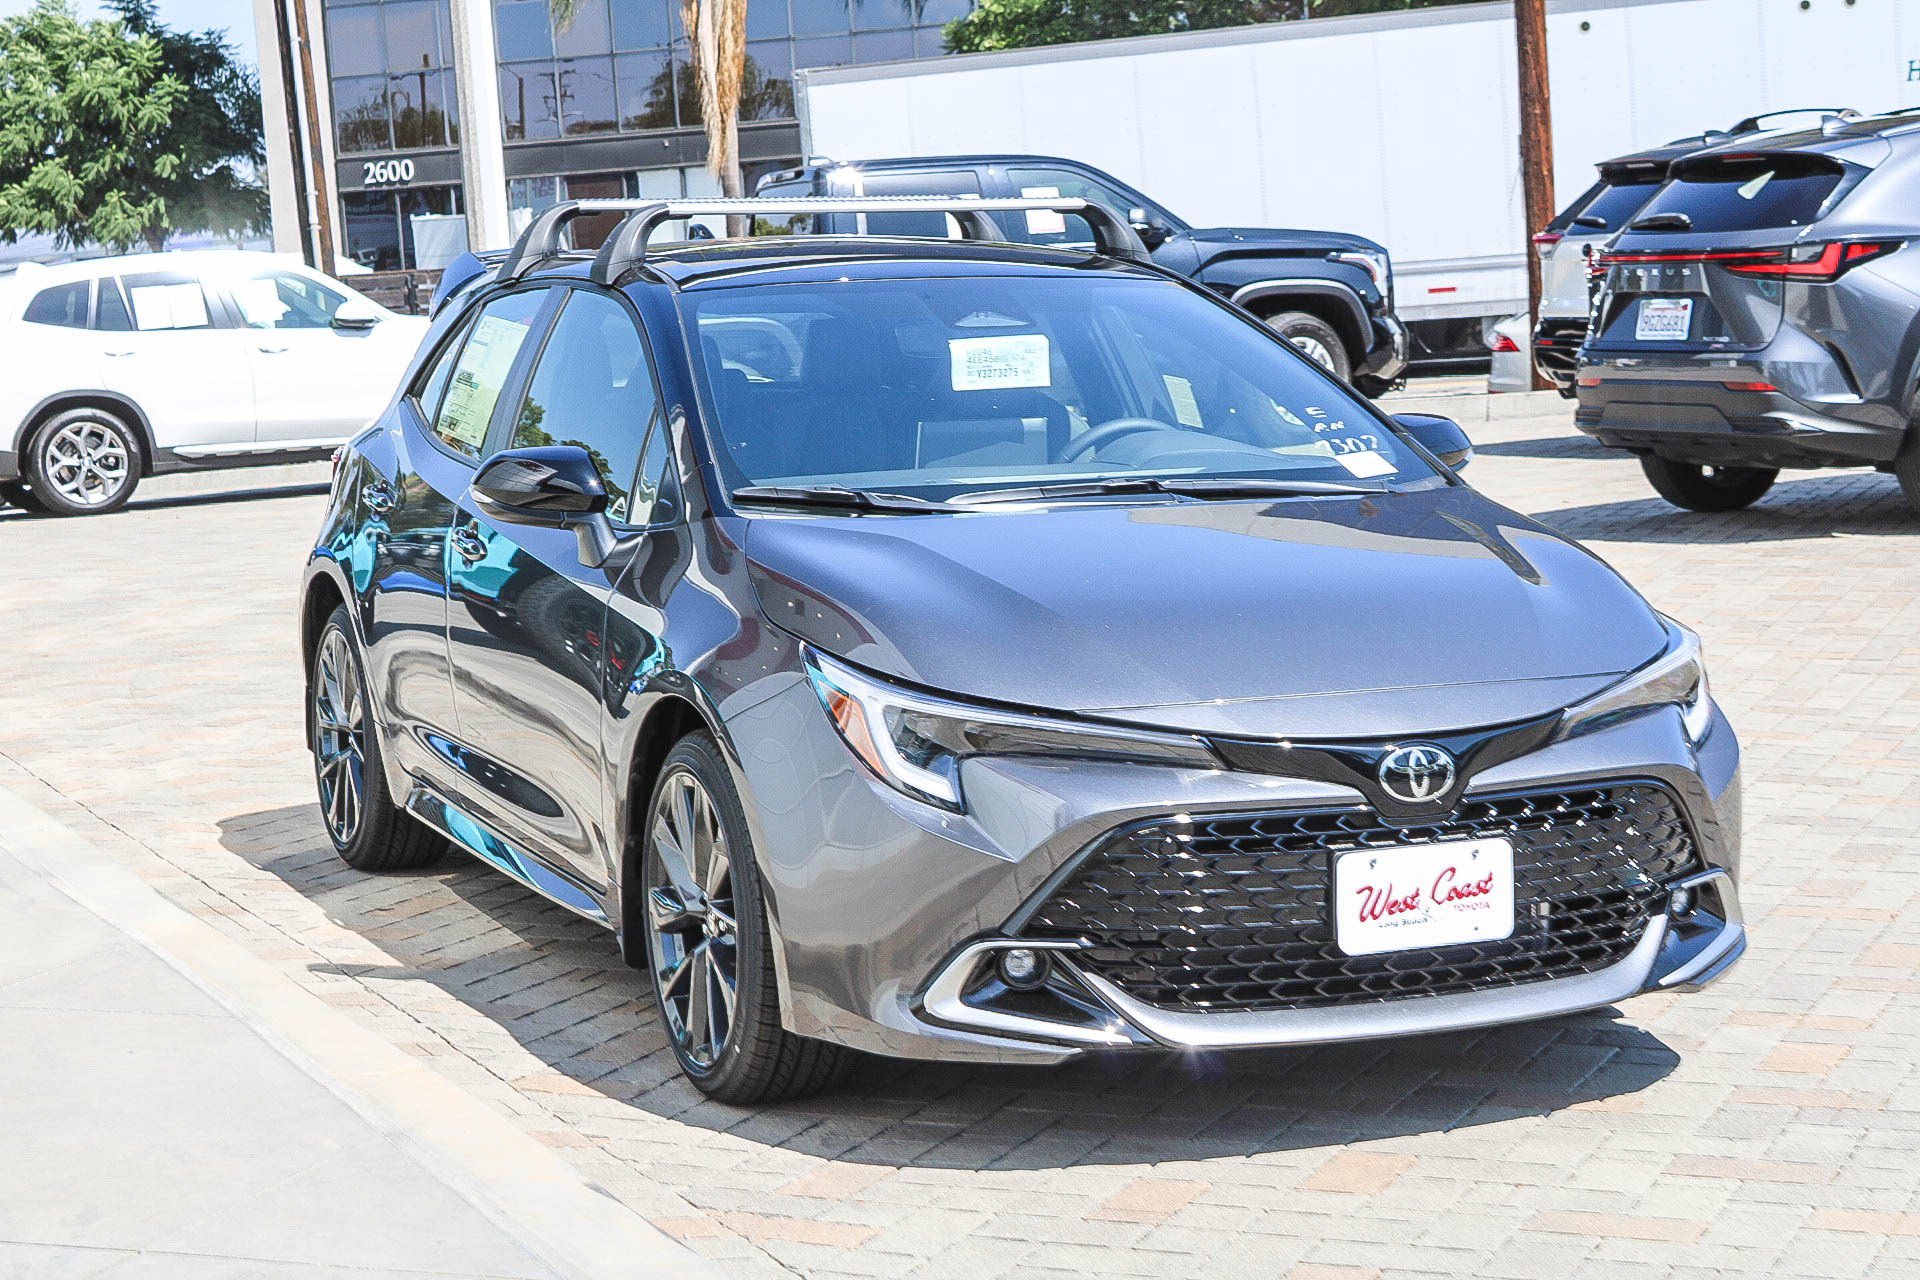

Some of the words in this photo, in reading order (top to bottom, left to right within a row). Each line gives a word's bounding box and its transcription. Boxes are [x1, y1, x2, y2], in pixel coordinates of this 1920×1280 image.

[363, 159, 415, 184] 2600
[1623, 268, 1692, 276] LEXUS
[1356, 882, 1421, 923] West
[1430, 866, 1494, 905] Coast
[1453, 901, 1491, 912] TOYOTA
